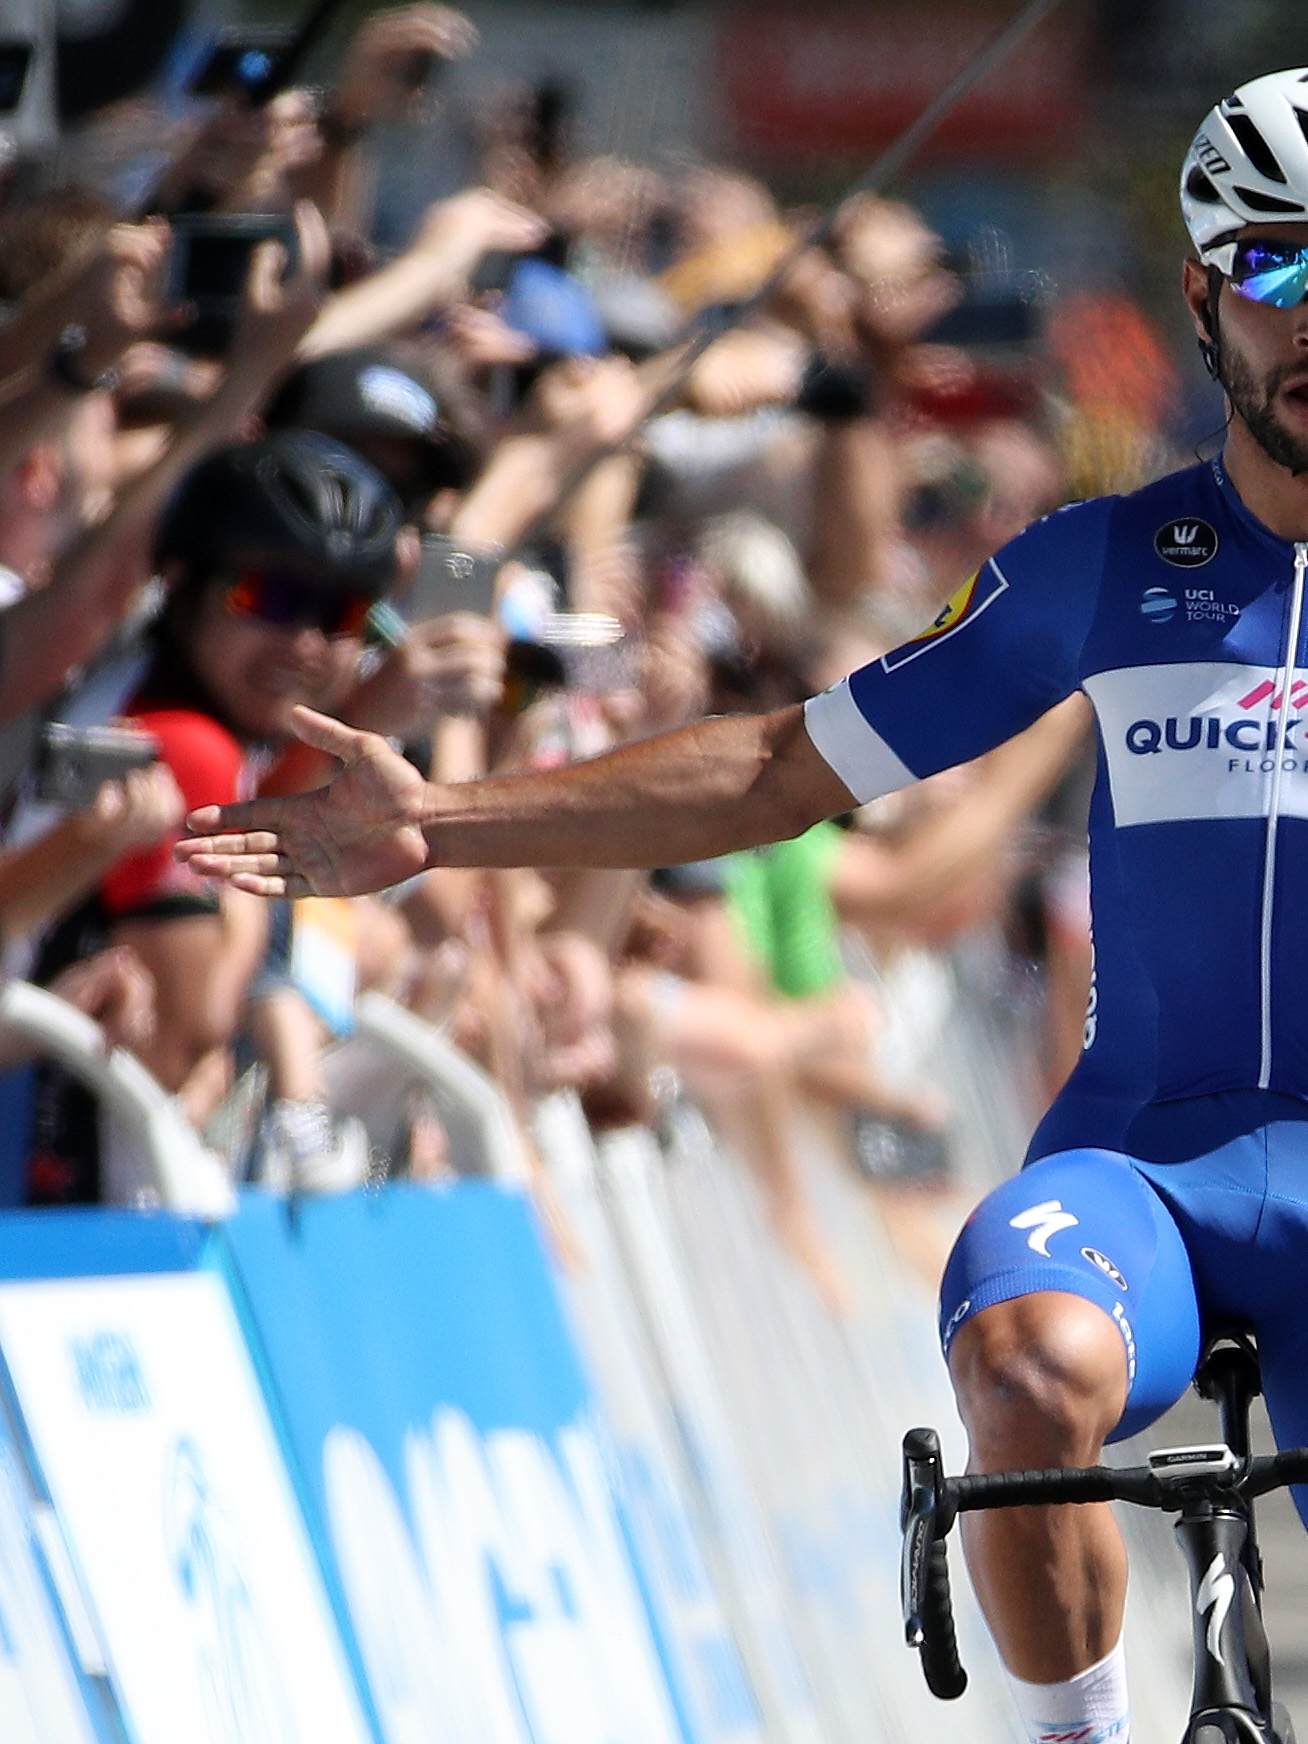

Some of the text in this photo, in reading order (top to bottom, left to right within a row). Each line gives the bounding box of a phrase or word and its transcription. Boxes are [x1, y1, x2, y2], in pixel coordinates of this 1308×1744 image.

[1184, 588, 1214, 600] UCI
[1185, 601, 1240, 616] WORLD
[1186, 611, 1226, 622] TOUR
[1167, 1453, 1207, 1462] GARMIN
